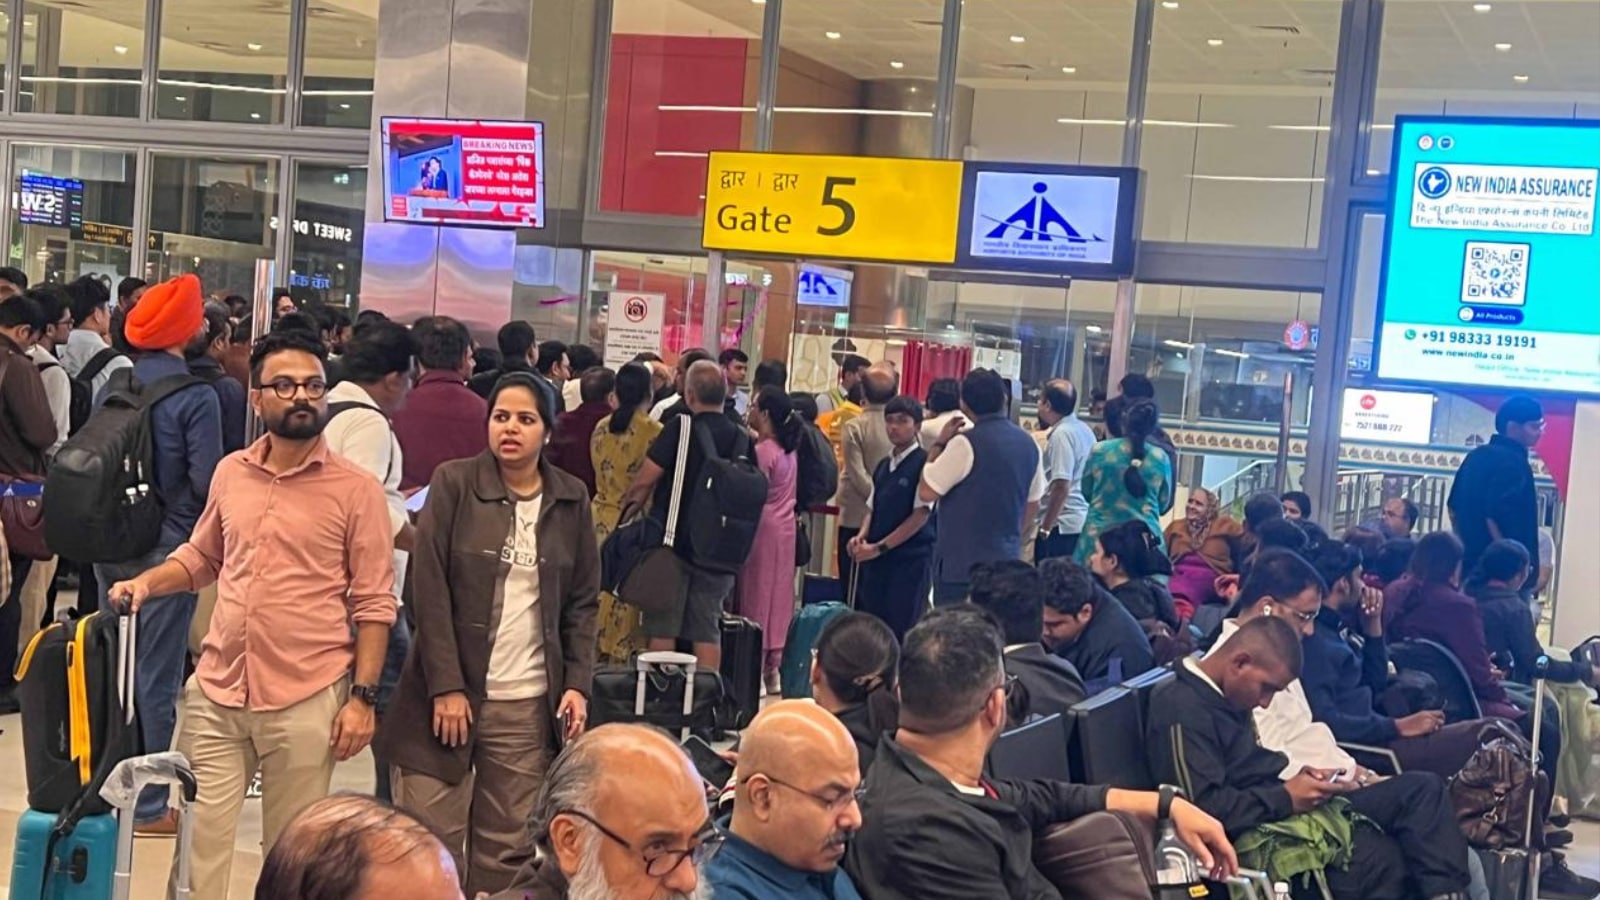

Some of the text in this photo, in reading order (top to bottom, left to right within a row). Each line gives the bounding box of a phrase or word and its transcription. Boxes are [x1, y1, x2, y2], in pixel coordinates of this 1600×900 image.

[463, 141, 534, 151] BREAKING NEWS
[720, 170, 746, 189] द्वार
[772, 172, 800, 192] द्वार
[1455, 175, 1593, 198] NEW INDIA ASSURANCE
[717, 176, 857, 237] Gate 5
[1415, 215, 1433, 225] The
[1436, 216, 1459, 226] New
[1462, 217, 1489, 227] India
[1492, 218, 1548, 230] Assurance
[1422, 330, 1538, 349] +91 98333 19191
